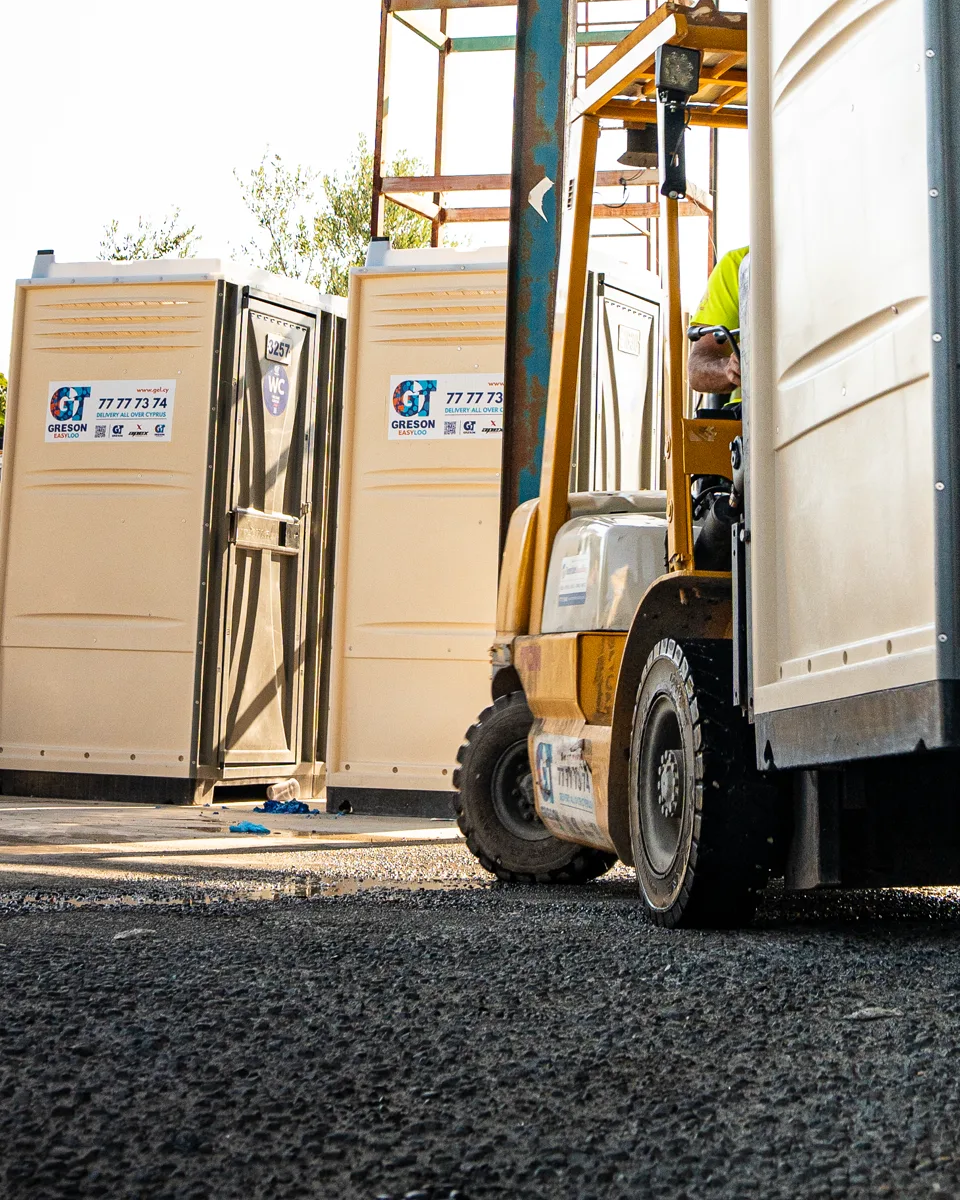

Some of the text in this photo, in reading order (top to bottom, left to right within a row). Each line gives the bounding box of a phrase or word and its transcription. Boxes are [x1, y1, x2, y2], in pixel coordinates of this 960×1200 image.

[268, 339, 291, 358] 3257
[268, 375, 285, 395] WC
[98, 397, 168, 409] 77 77 73 74
[446, 392, 503, 404] 77 77 73
[48, 423, 87, 433] GRESON
[391, 419, 436, 429] GRESON
